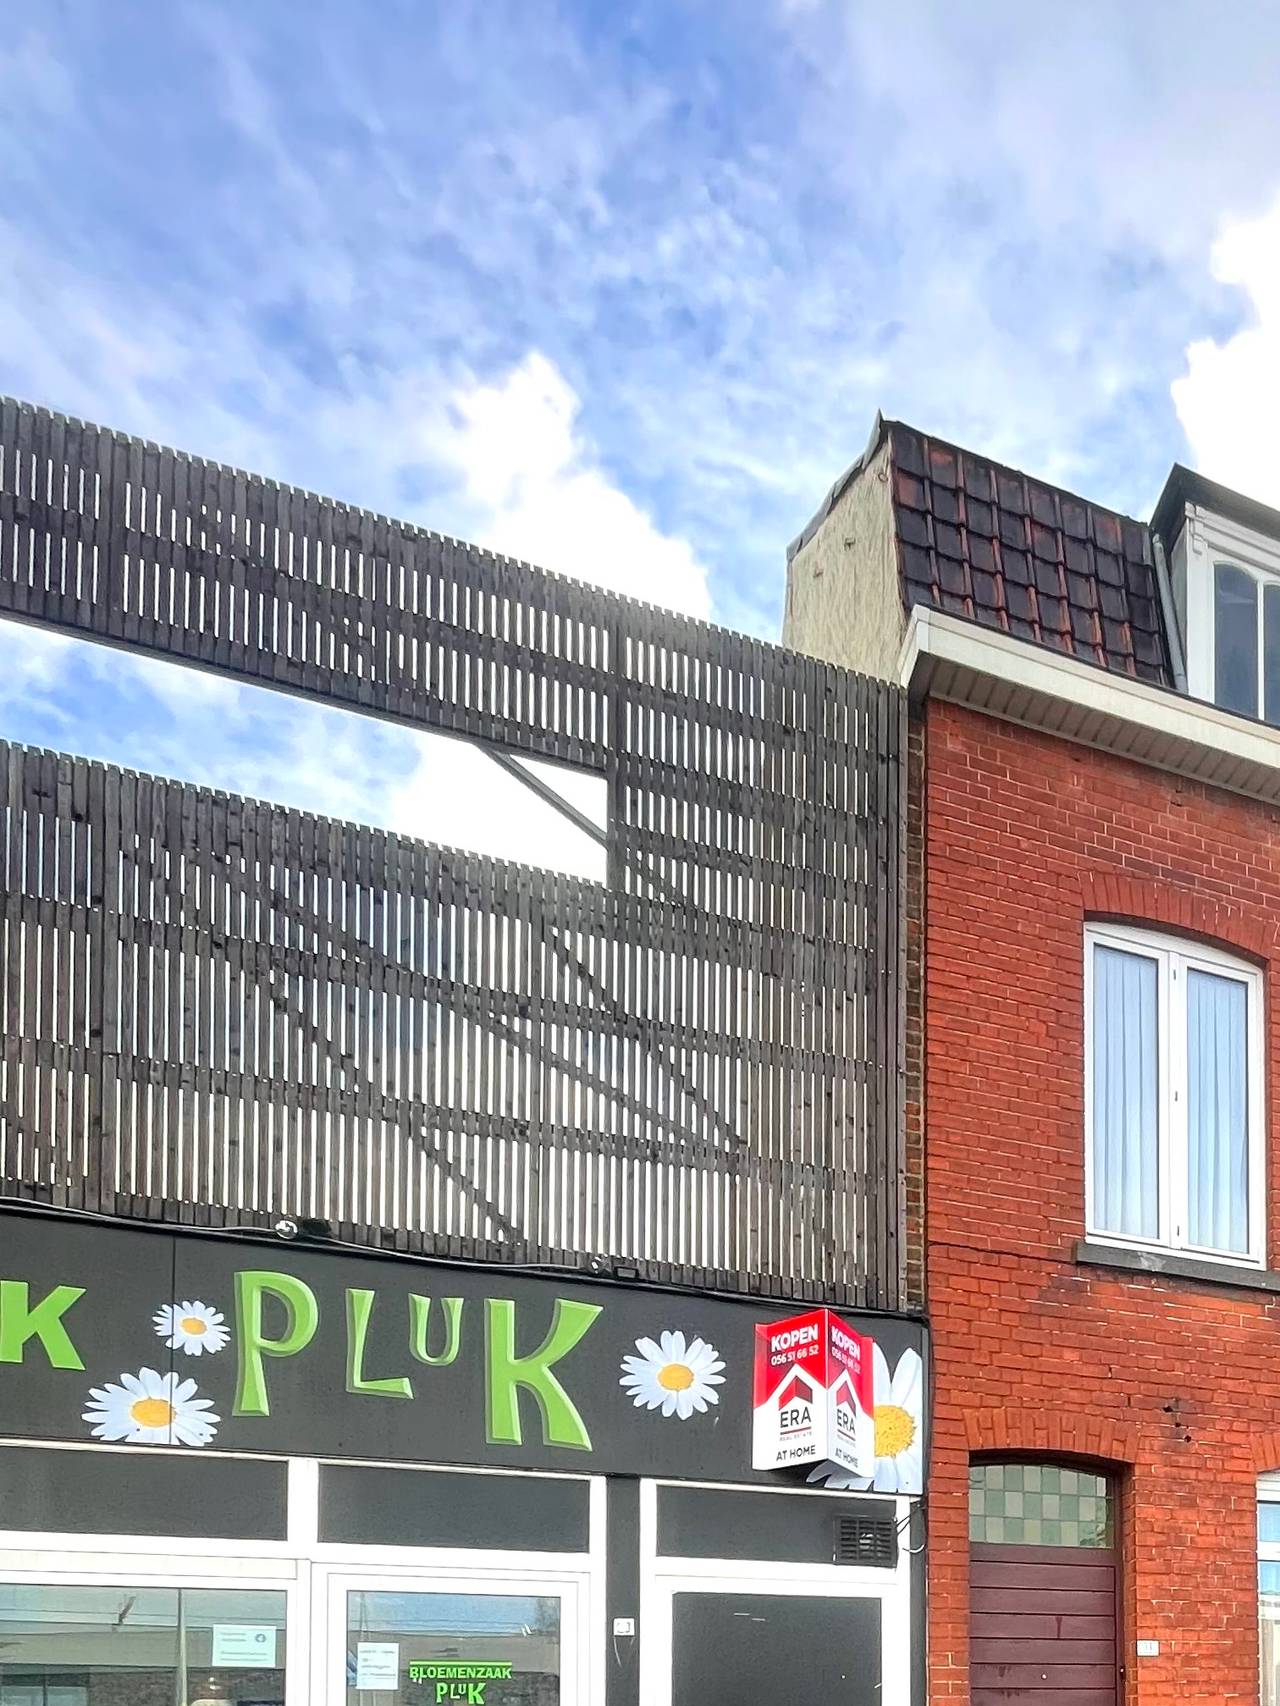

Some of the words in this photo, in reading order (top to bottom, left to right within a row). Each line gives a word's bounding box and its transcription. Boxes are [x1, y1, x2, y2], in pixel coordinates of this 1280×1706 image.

[771, 1323, 818, 1352] KOPEN
[831, 1325, 861, 1361] KOPEN
[232, 1270, 604, 1452] PLUK
[771, 1354, 787, 1366] 056
[787, 1351, 796, 1362] 51
[796, 1348, 808, 1360] 66
[809, 1344, 819, 1356] 52
[780, 1406, 812, 1428] ERA
[836, 1409, 856, 1435] ERA
[776, 1450, 788, 1461] AT
[789, 1444, 816, 1459] HOME
[409, 1667, 512, 1679] BLOEMENZAAK
[436, 1682, 486, 1705] PLUK
